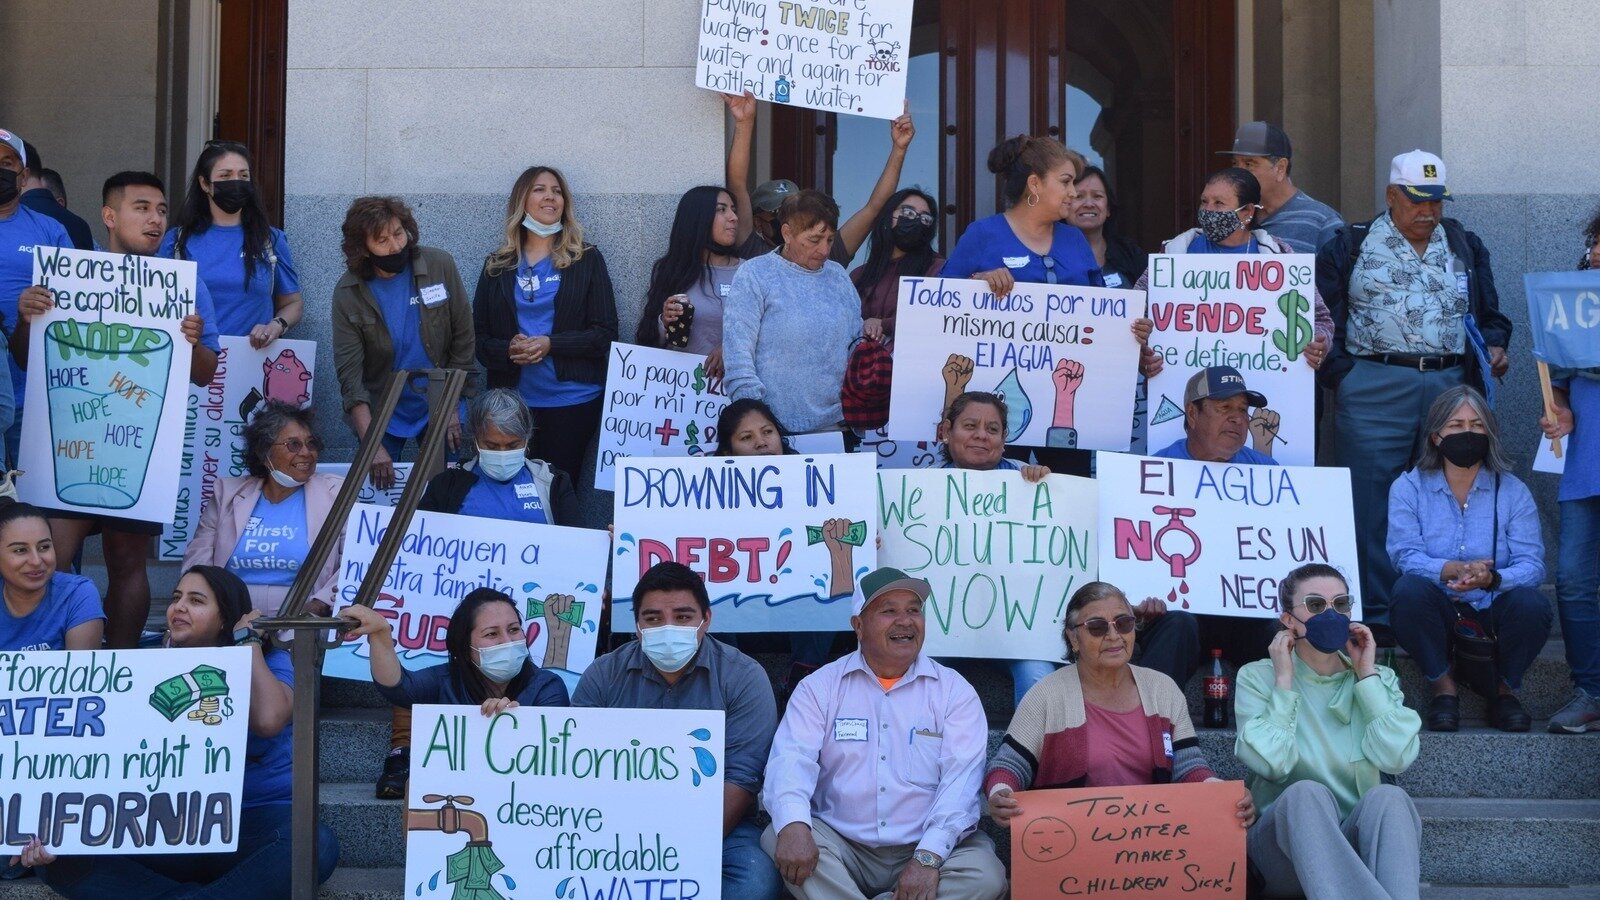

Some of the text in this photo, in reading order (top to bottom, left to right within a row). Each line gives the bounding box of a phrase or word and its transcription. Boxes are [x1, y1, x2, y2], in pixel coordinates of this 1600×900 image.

[706, 0, 893, 39] paying TWICE for
[776, 34, 819, 54] once
[828, 36, 862, 60] for
[700, 43, 889, 90] water and again for
[865, 60, 901, 73] TOXIC
[706, 66, 864, 113] bottled water.
[37, 247, 177, 301] We are filing
[1153, 257, 1174, 288] El
[1182, 269, 1230, 301] agua
[1236, 260, 1284, 291] NO
[1288, 265, 1312, 286] se
[74, 284, 143, 322] capitol
[149, 288, 193, 320] whit
[903, 278, 962, 308] Todos
[1046, 293, 1084, 322] por
[1091, 297, 1126, 318] una
[943, 313, 1015, 340] misma
[1152, 302, 1269, 337] VENDE,
[53, 318, 161, 367] HOPE
[975, 342, 1054, 372] El AGUA
[1152, 344, 1178, 366] se
[50, 367, 89, 387] HOPE
[108, 371, 151, 408] HOPE
[616, 347, 637, 380] Yo
[644, 366, 689, 397] pago
[72, 395, 112, 424] HOPE
[610, 390, 645, 413] por
[655, 393, 685, 413] mi
[57, 439, 95, 460] HOPE
[104, 423, 144, 449] HOPE
[205, 427, 222, 448] su
[605, 417, 652, 446] agua
[89, 465, 127, 487] HOPE
[624, 459, 783, 509] DROWNING
[1140, 460, 1300, 506] El AGUA
[876, 472, 1053, 530] We Need A
[244, 539, 279, 553] For
[402, 517, 506, 574] ahoguen
[520, 544, 540, 565] a
[903, 521, 1089, 572] SOLUTION
[1113, 506, 1202, 577] NO
[1236, 526, 1329, 563] ES UN
[230, 555, 300, 570] Justice
[345, 556, 423, 594] nustra
[12, 735, 231, 792] human right in
[422, 712, 679, 781] All Californias
[0, 790, 233, 848] LIFORNIA
[497, 782, 603, 832] deserve
[1091, 824, 1190, 842] WATER
[535, 832, 680, 872] affordable
[1115, 850, 1187, 864] MAKES
[1059, 876, 1169, 895] CHILDREN
